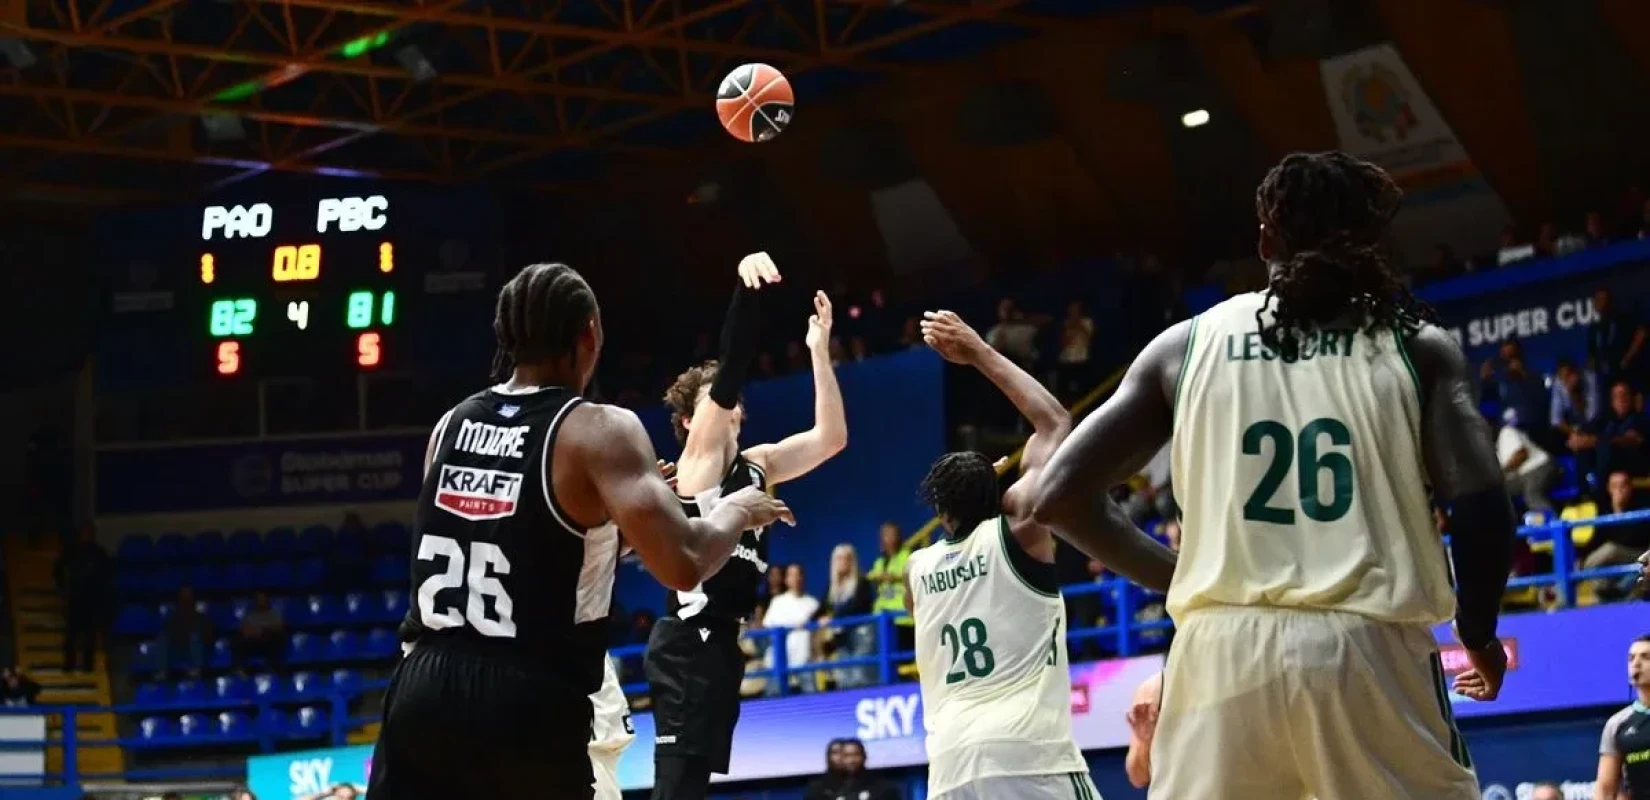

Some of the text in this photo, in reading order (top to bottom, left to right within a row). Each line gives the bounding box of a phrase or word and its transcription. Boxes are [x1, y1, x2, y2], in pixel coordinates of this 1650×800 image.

[202, 203, 273, 240] PAO
[317, 195, 389, 233] PBC
[210, 298, 257, 336] 82
[287, 300, 309, 330] 4
[347, 291, 395, 328] 81
[1467, 308, 1548, 346] SUPER
[1556, 297, 1601, 329] CU
[218, 341, 239, 374] 5
[358, 333, 380, 366] 5
[454, 418, 530, 459] MOORE
[441, 468, 519, 497] KRAFT
[1242, 417, 1353, 525] 26
[458, 499, 495, 512] PAINTS
[417, 534, 517, 638] 26
[940, 617, 995, 685] 28
[856, 693, 918, 740] SKY
[289, 757, 333, 796] SKY
